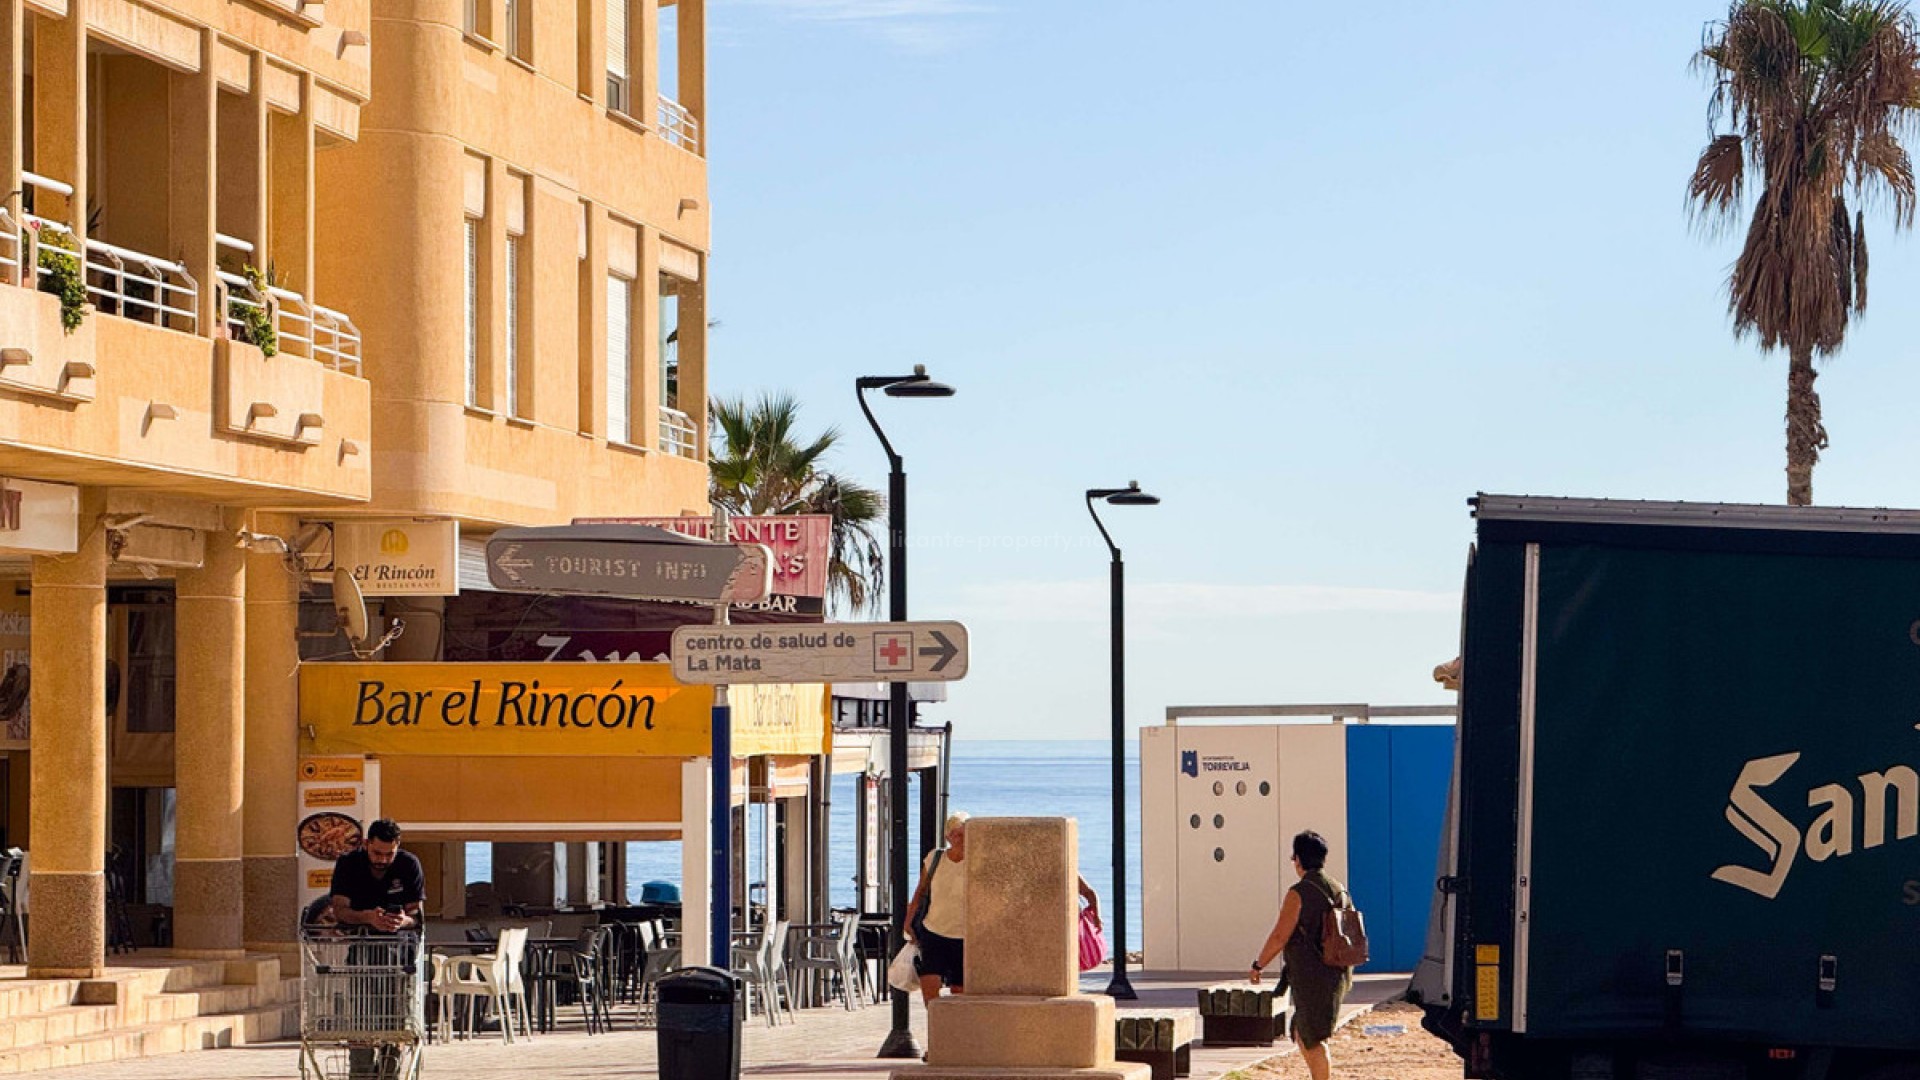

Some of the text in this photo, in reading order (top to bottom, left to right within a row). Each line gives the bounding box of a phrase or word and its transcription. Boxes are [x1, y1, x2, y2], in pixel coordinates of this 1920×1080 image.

[650, 520, 800, 541] AURANTE
[353, 563, 435, 581] El Rincón
[545, 556, 706, 580] TOURIST INFO
[686, 633, 745, 650] centro
[751, 633, 772, 649] de
[778, 632, 827, 649] salud
[833, 632, 855, 648] de
[687, 655, 761, 671] La Mata
[352, 678, 656, 730] Bar el Rincón
[1710, 751, 1919, 900] San
